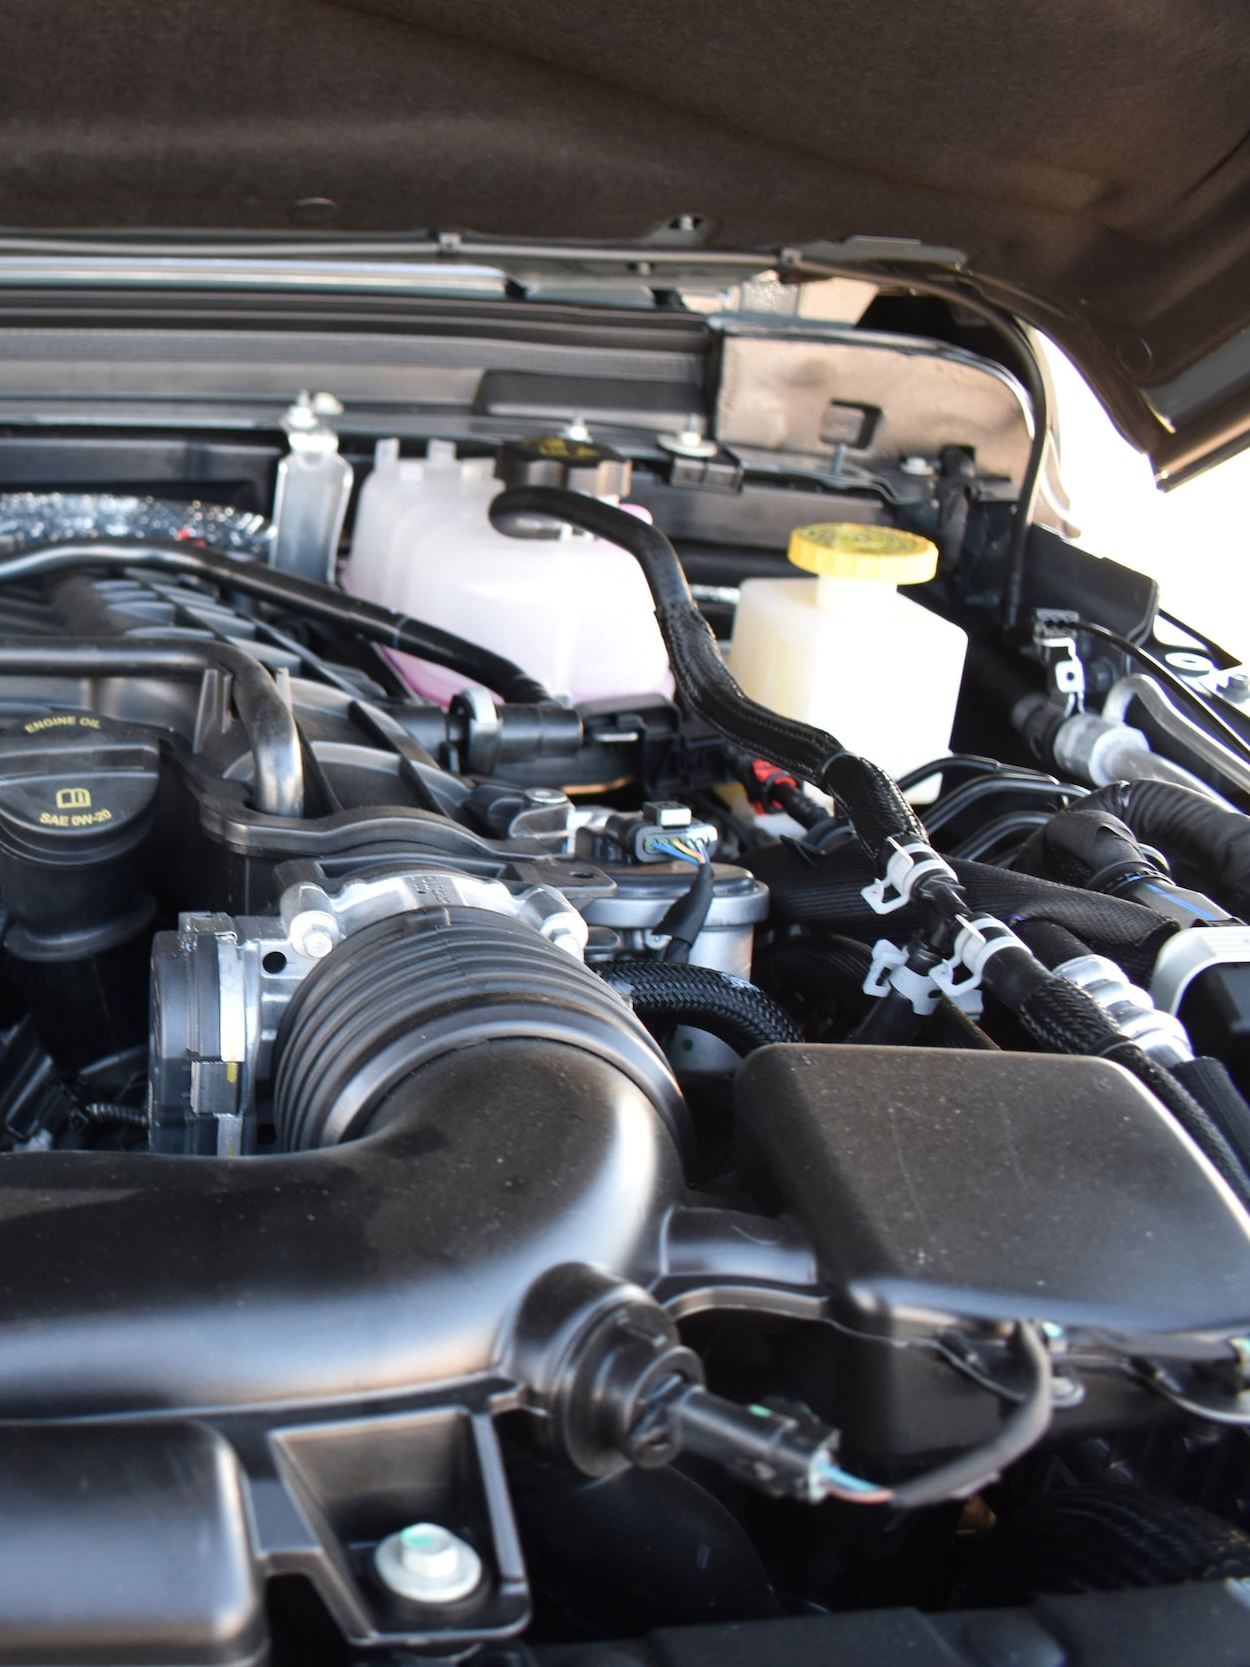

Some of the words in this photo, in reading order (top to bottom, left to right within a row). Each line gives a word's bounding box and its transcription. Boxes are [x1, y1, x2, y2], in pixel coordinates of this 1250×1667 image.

[24, 716, 76, 733] ENGINE
[80, 717, 101, 729] OIL
[39, 812, 69, 826] SAE
[71, 808, 112, 826] 0W-20
